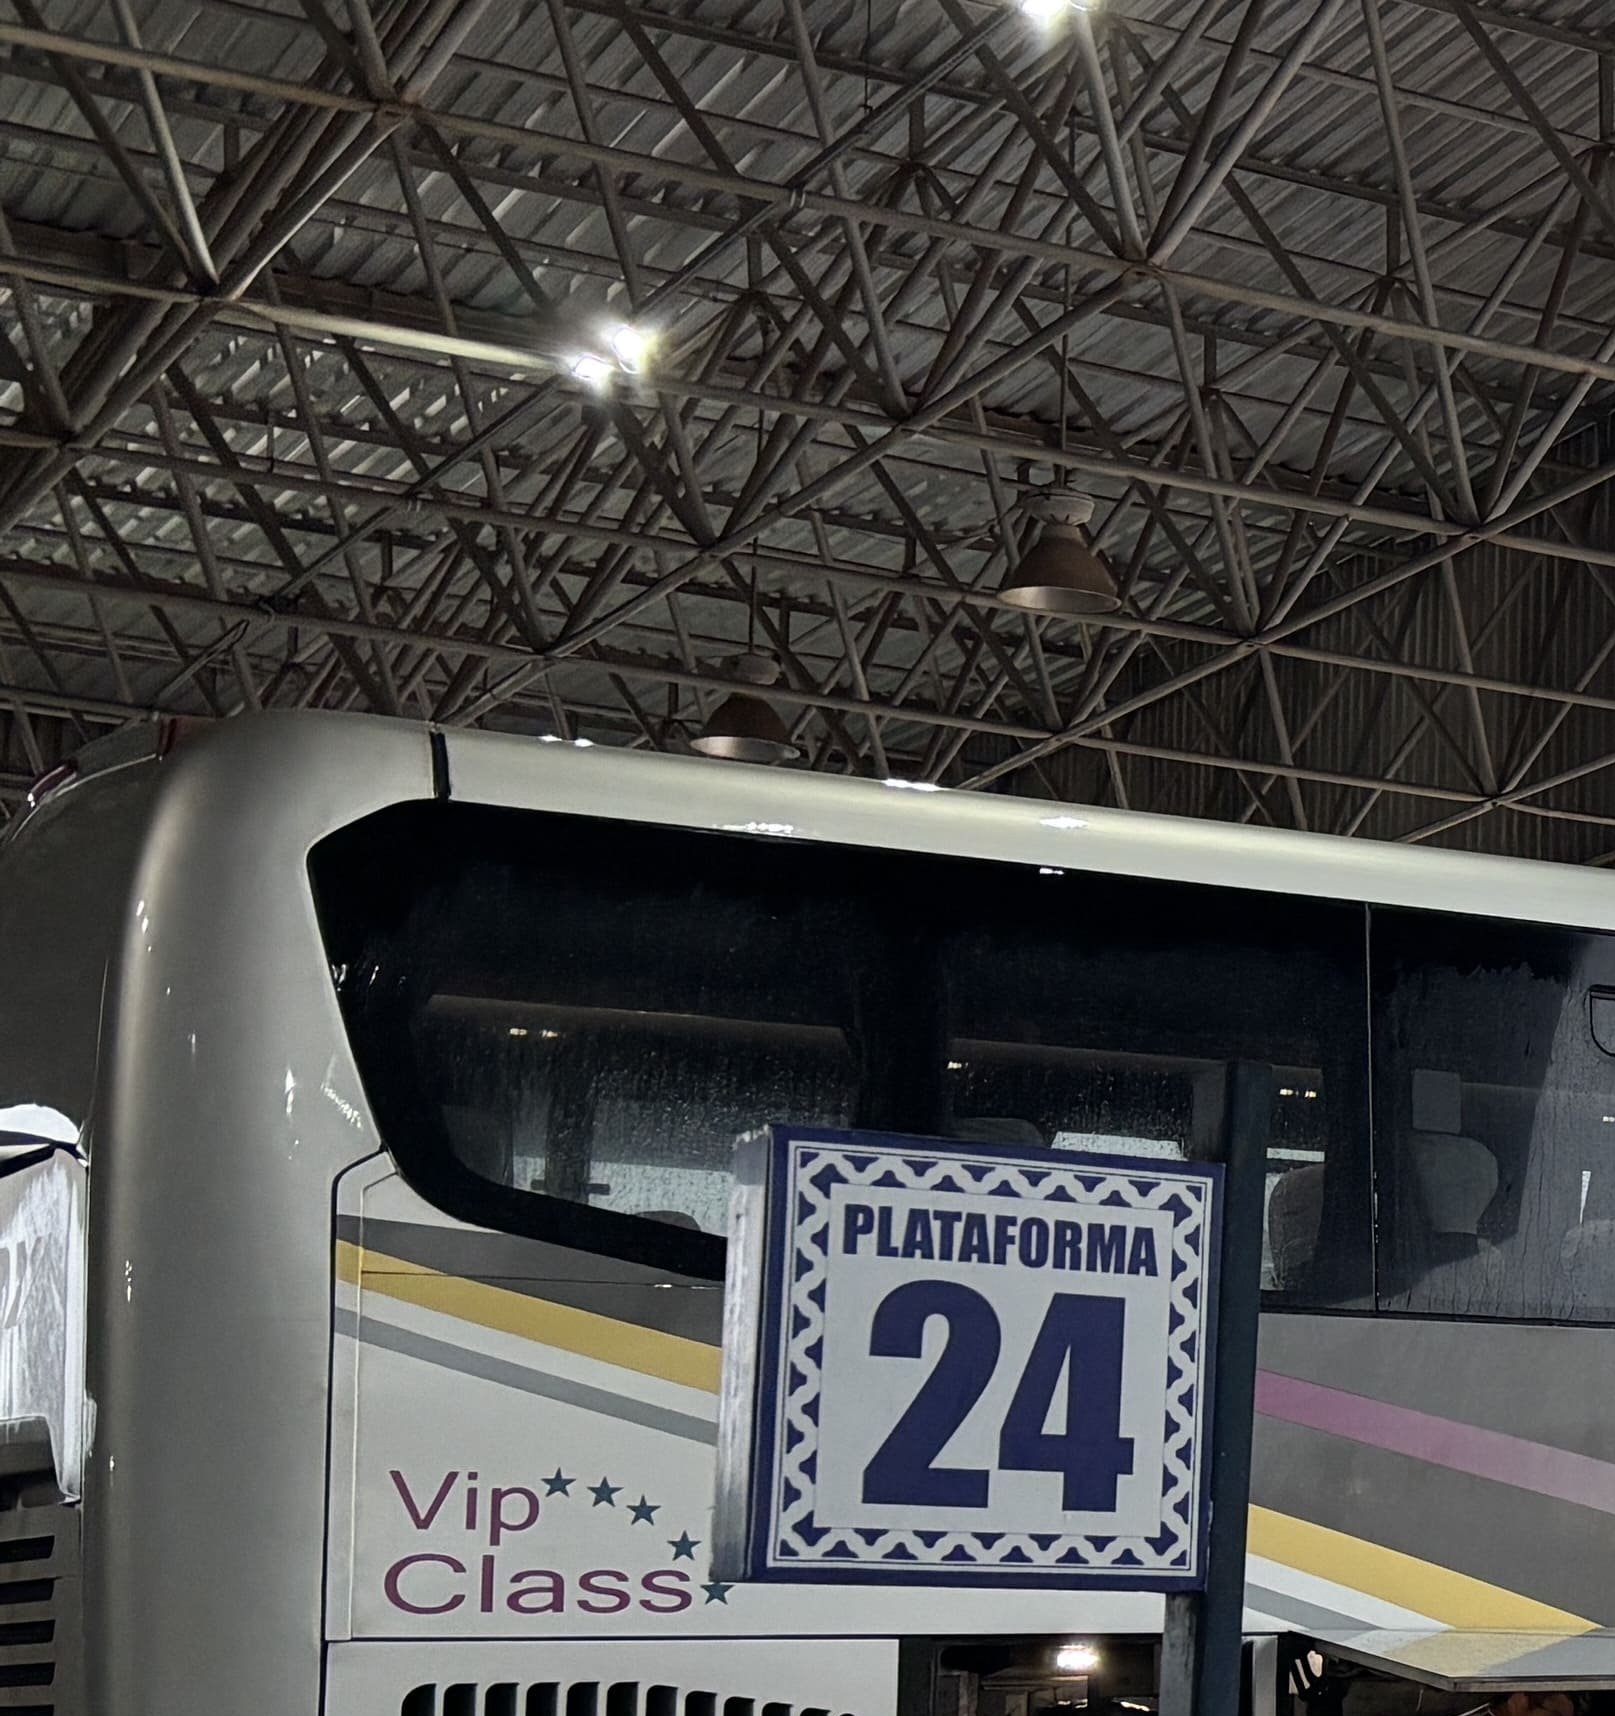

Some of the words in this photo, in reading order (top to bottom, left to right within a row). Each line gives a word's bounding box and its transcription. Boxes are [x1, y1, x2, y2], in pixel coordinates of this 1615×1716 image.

[841, 1203, 1159, 1277] PLATAFORMA
[862, 1279, 1134, 1513] 24
[388, 1469, 540, 1546] Vip
[383, 1554, 694, 1615] Class
